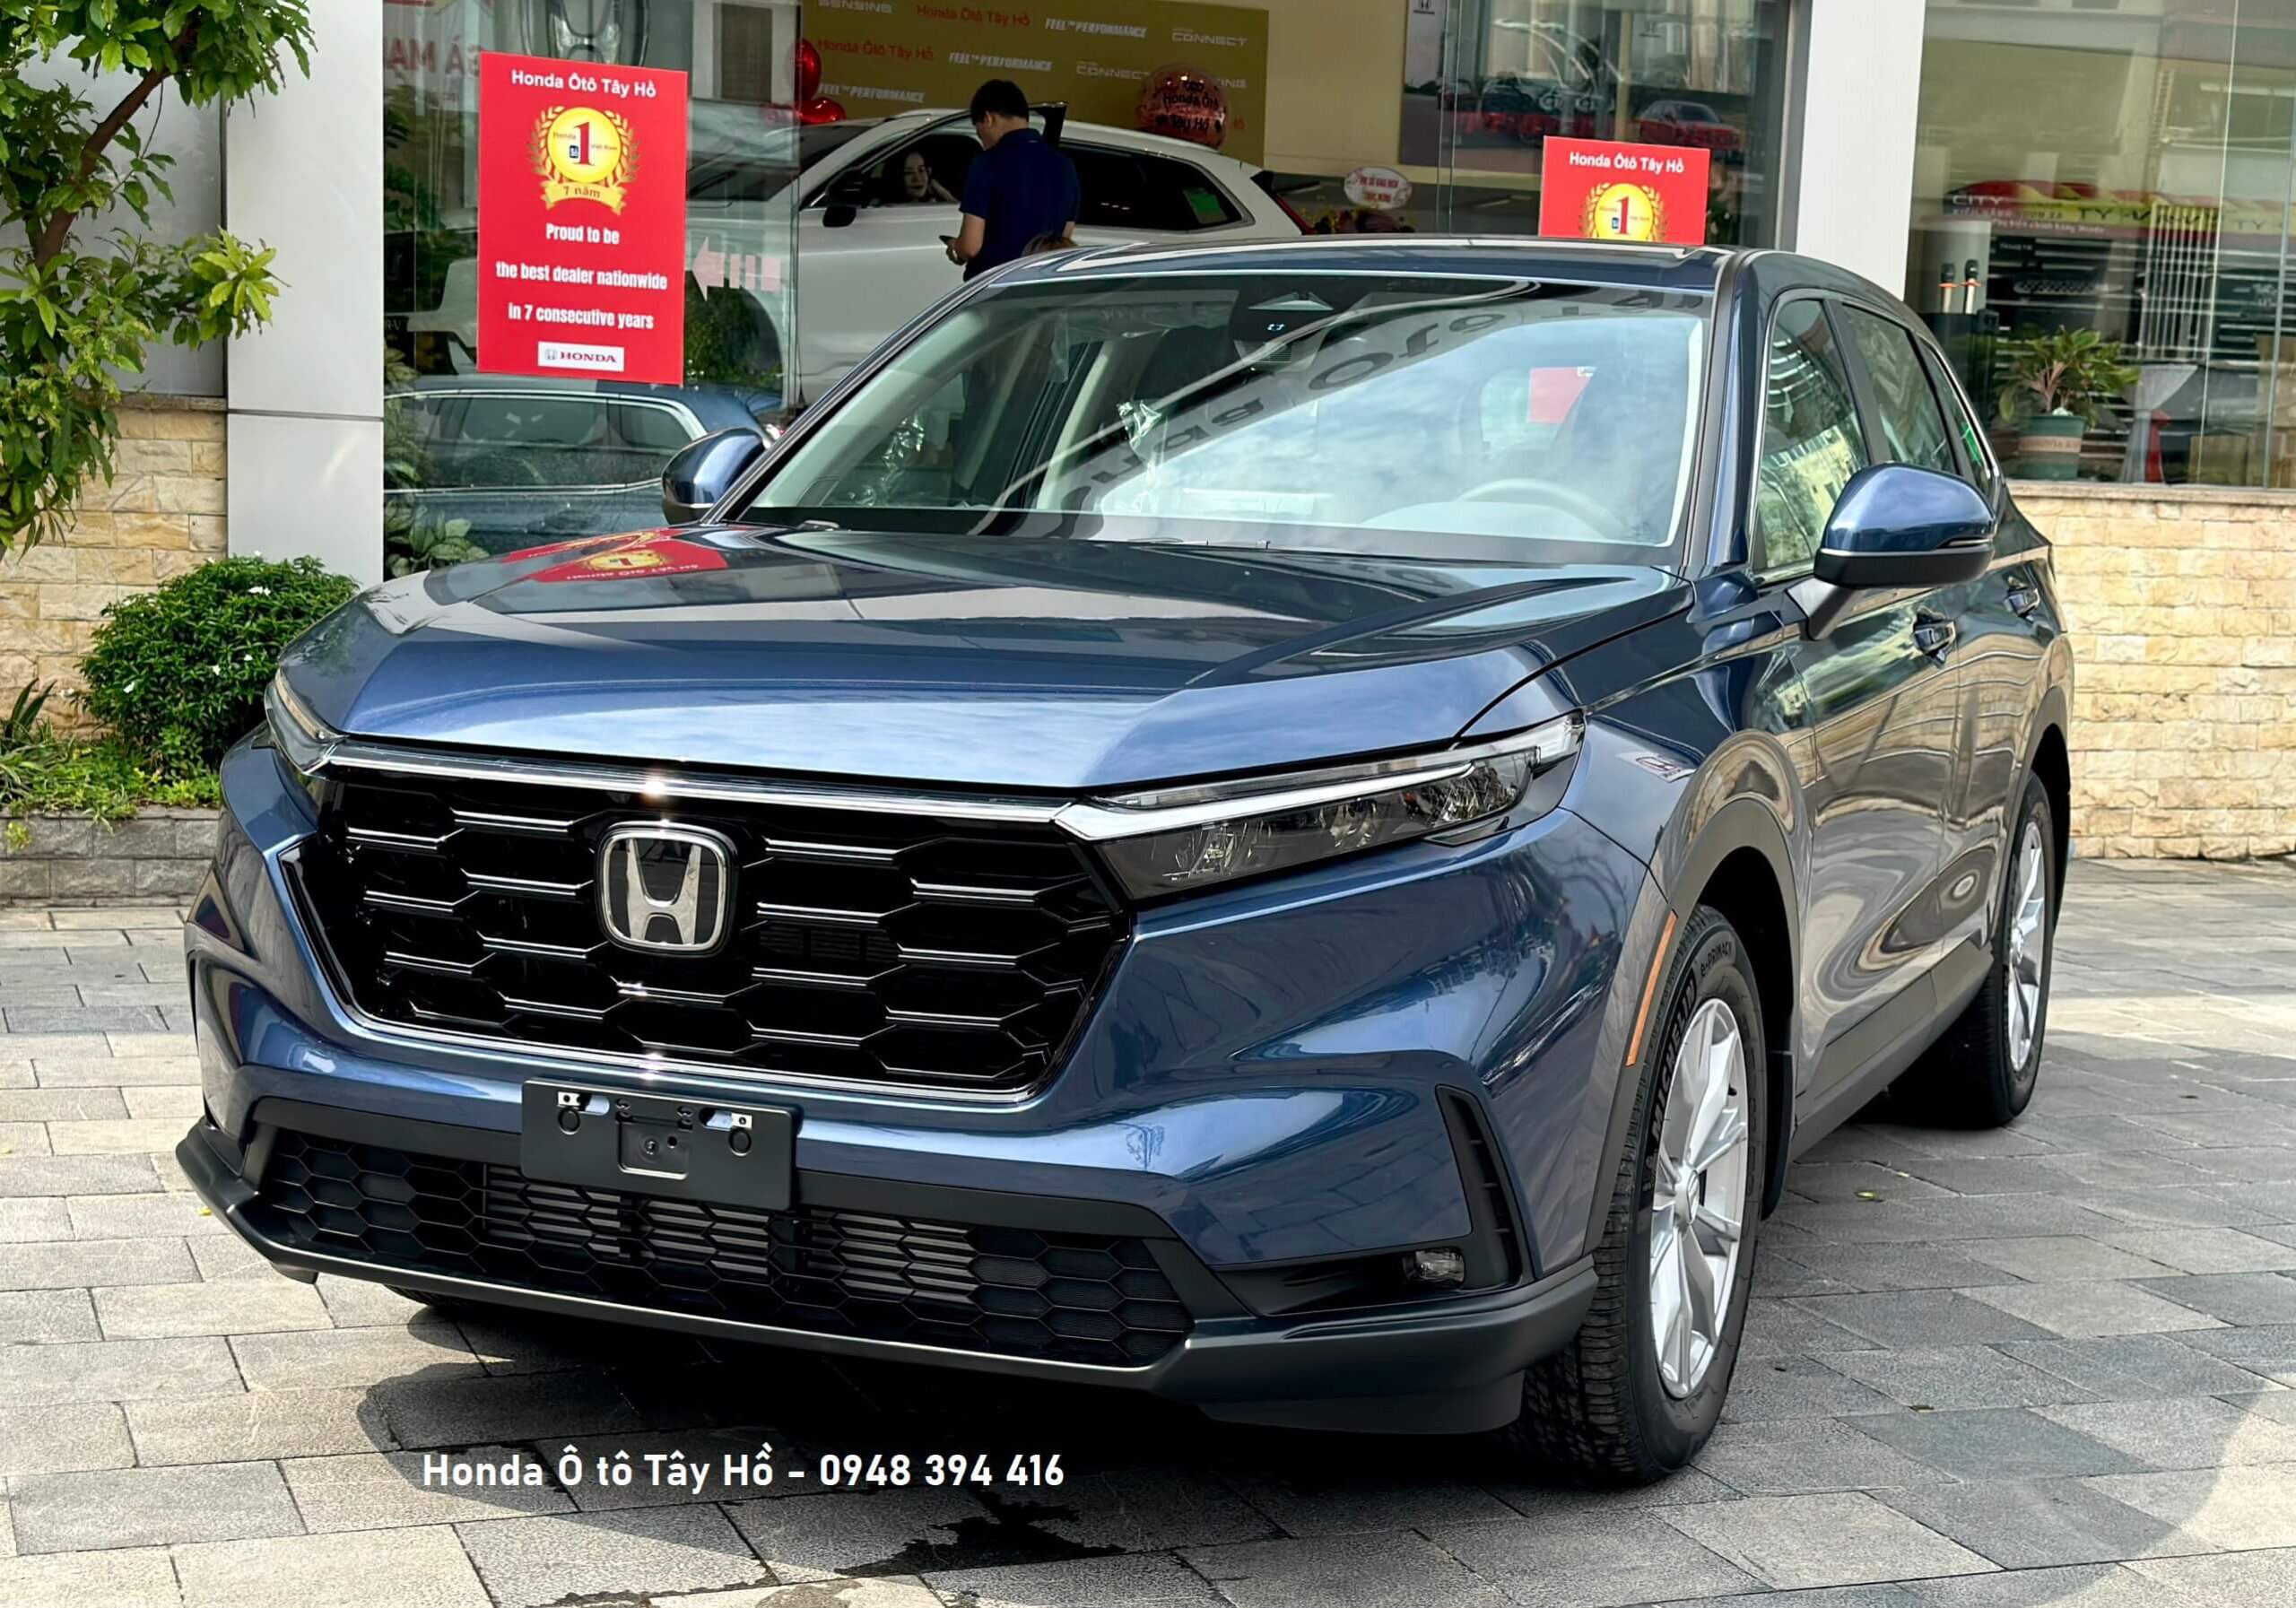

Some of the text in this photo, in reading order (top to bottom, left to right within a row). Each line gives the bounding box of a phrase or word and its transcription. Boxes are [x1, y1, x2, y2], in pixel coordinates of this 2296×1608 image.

[916, 4, 958, 21] Honda
[1172, 31, 1248, 46] CONNECT
[511, 69, 657, 98] Honda Ôtô Tây Hồ
[573, 122, 596, 166] 1
[1570, 151, 1684, 175] Honda Ôtô Tây Hồ
[562, 186, 600, 198] 7 năm
[1952, 195, 2004, 206] CITY
[546, 222, 620, 245] Proud to be
[496, 261, 667, 290] the best dealer nationwide
[525, 304, 533, 321] 7
[536, 307, 614, 326] consecutive
[618, 314, 654, 330] years
[561, 351, 617, 363] HONDA
[1651, 978, 1696, 1143] MICHELIN
